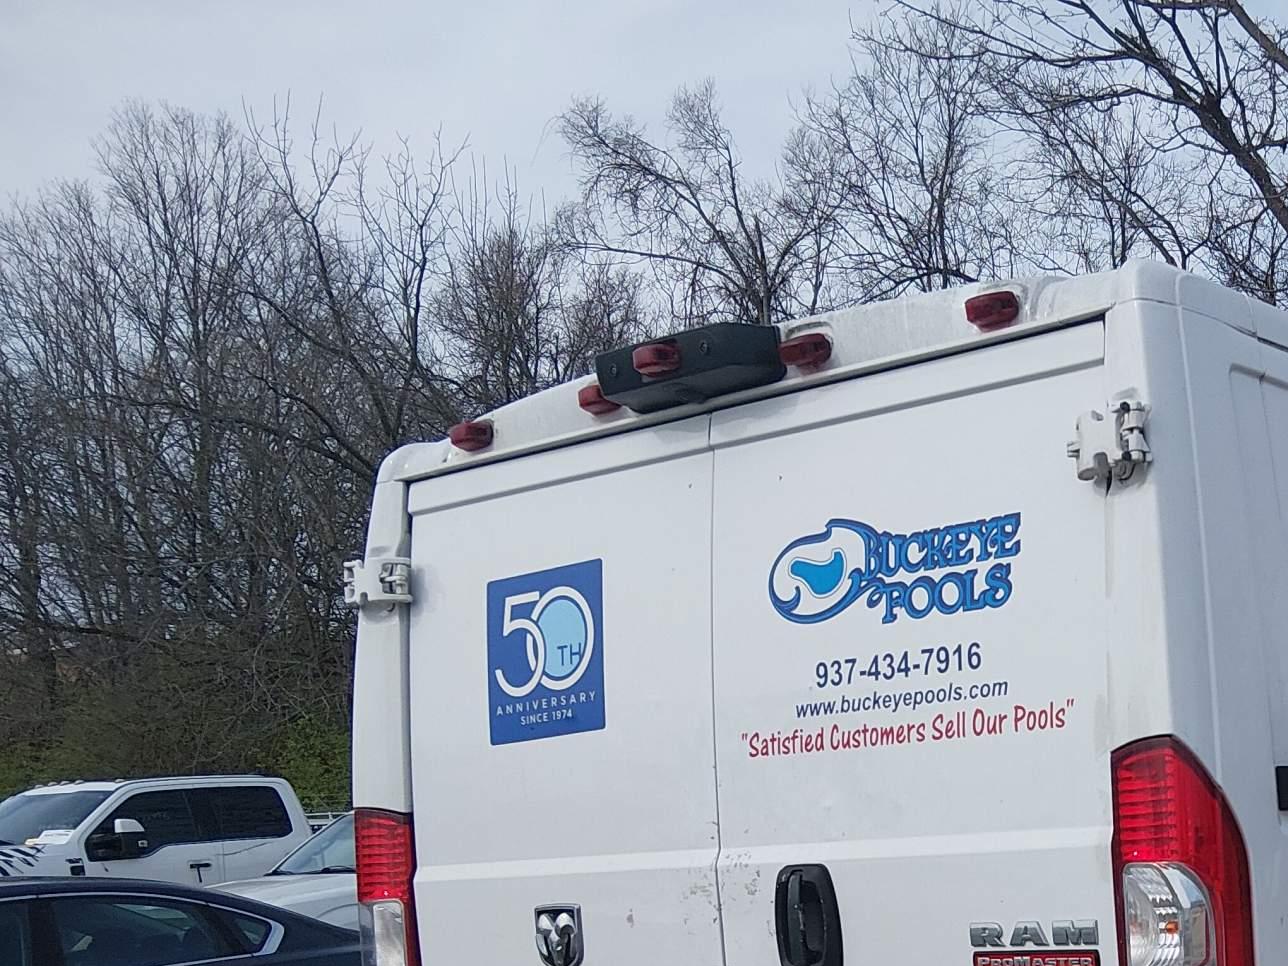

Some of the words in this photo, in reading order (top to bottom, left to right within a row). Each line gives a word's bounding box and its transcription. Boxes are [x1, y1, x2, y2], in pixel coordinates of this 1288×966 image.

[864, 512, 1021, 580] BUCKEYE
[866, 563, 1013, 624] POOLS
[815, 642, 982, 688] 937-434-7916
[496, 691, 596, 716] ANNIVERSARY
[520, 712, 549, 726] SINCE
[552, 708, 572, 721] 1974
[795, 681, 1009, 718] www.buckeyepools.com
[741, 729, 825, 758] "Satisfied
[830, 717, 926, 751] Customers
[931, 712, 966, 741] Sell
[972, 707, 1008, 737] Our
[1013, 698, 1075, 733] Pools"
[969, 919, 1100, 947] RAM
